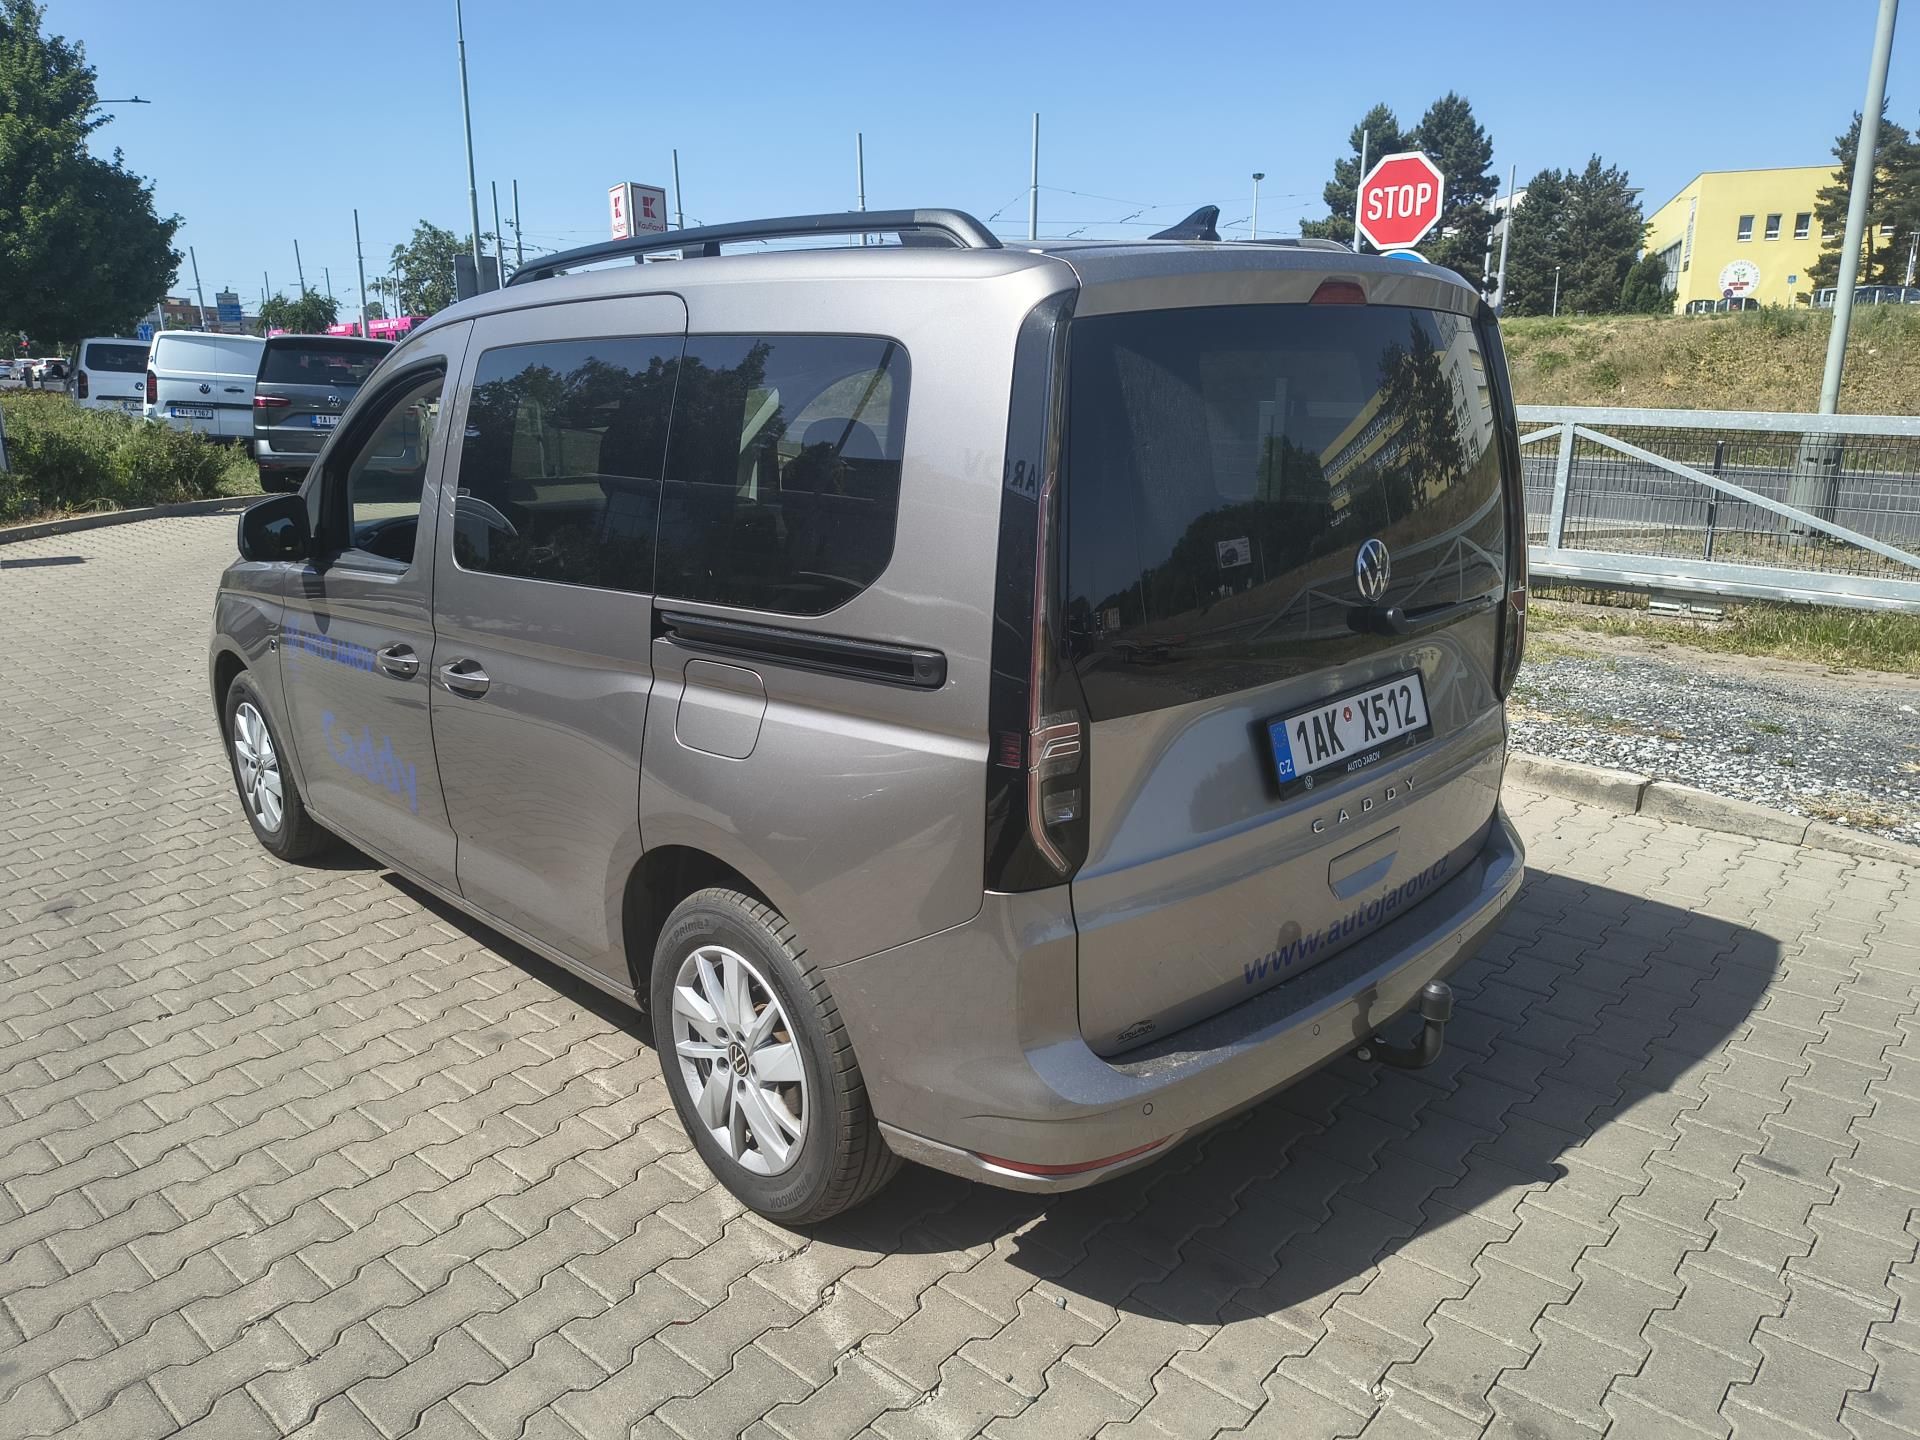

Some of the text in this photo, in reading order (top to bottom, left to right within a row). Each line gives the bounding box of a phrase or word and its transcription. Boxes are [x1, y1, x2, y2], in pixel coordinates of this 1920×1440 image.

[642, 196, 656, 219] K
[1367, 182, 1432, 221] STOP
[1296, 685, 1416, 765] 1AK X512
[1279, 758, 1294, 775] CZ
[1347, 751, 1380, 773] AUTO JAROV
[1312, 776, 1415, 834] CADDY
[1244, 853, 1449, 985] www.autojarov.cz
